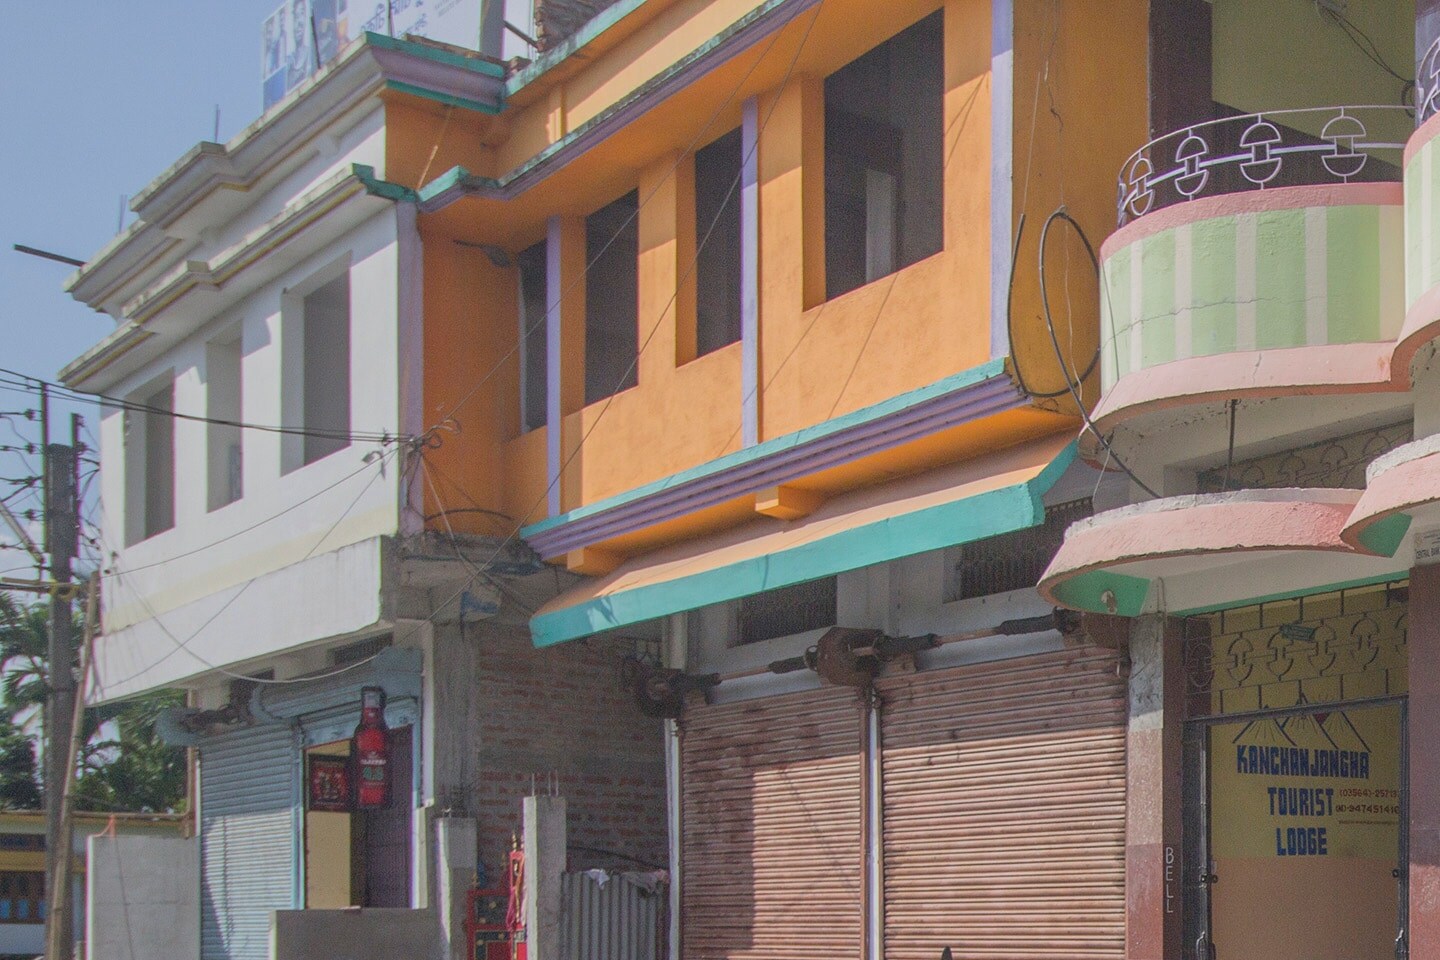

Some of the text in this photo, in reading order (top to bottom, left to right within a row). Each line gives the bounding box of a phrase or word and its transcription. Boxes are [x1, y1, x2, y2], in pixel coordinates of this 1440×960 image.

[1236, 744, 1370, 779] KANCHANJANGHA
[1267, 786, 1334, 816] TOURIST
[1276, 827, 1328, 856] LODGE
[1165, 846, 1175, 914] BELL
